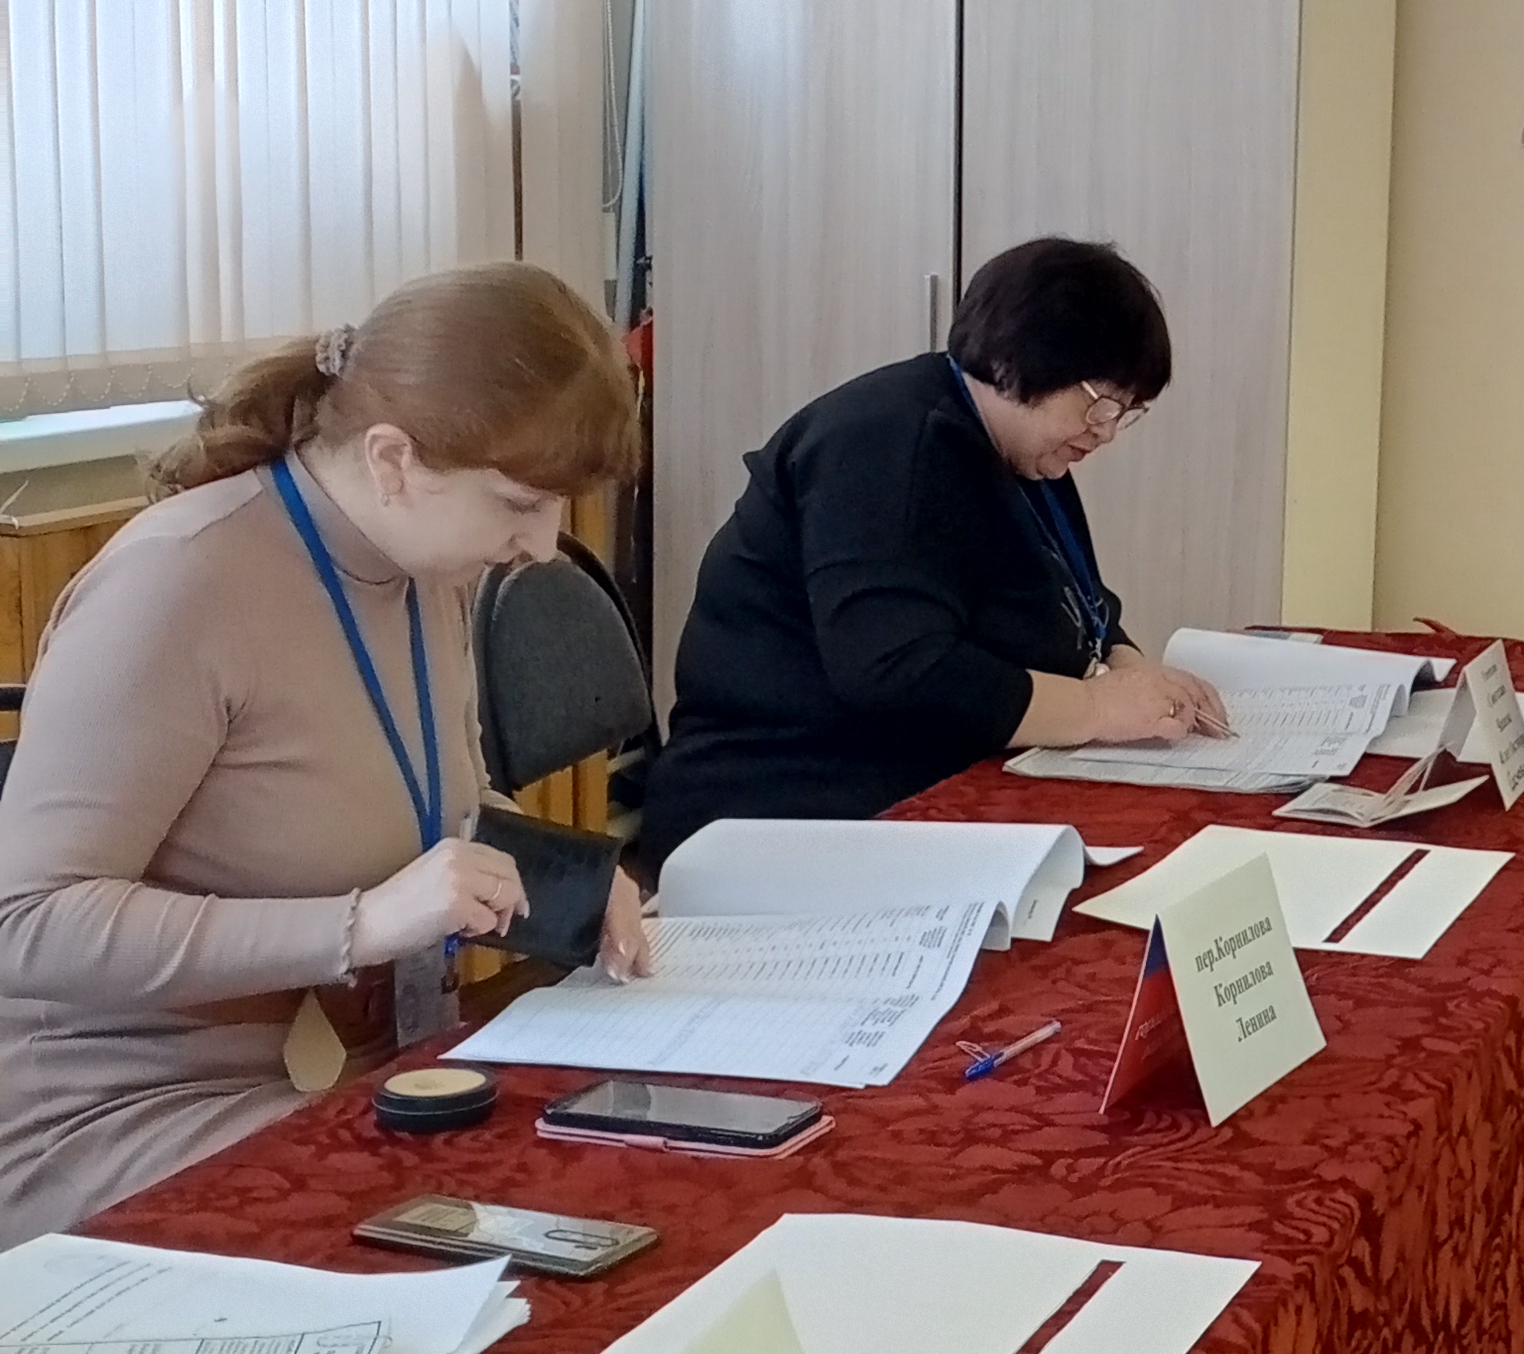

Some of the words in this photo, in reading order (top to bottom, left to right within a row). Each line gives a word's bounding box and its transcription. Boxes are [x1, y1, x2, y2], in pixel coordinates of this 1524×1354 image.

[1195, 917, 1273, 972] пер.Корнилова
[1213, 961, 1274, 1007] Корнилова
[1235, 1005, 1277, 1042] Ленина
